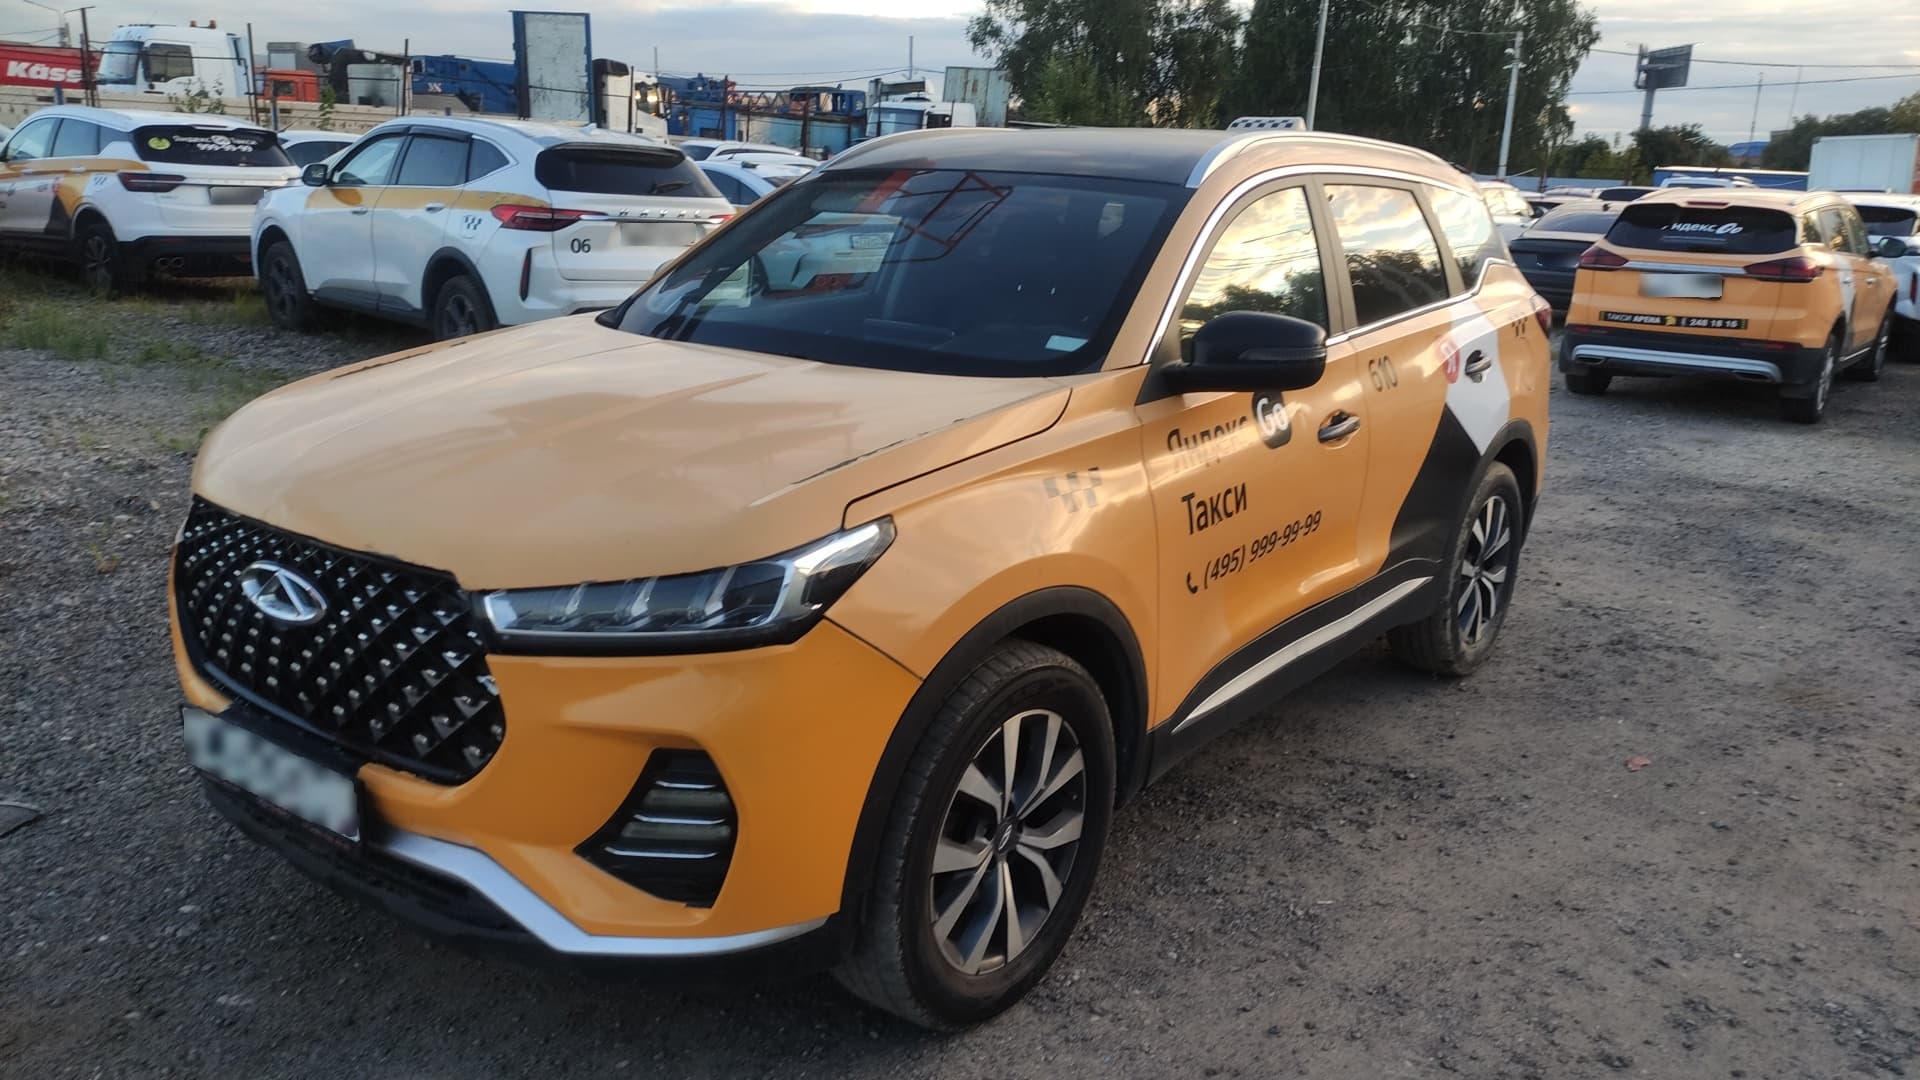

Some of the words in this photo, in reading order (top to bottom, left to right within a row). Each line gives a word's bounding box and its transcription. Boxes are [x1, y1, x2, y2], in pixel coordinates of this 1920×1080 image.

[6, 60, 97, 84] Käss
[570, 238, 592, 254] 06
[1367, 355, 1399, 393] 610
[1256, 397, 1289, 436] Go
[1181, 482, 1247, 536] Такси
[1203, 544, 1246, 590] (495)
[1249, 509, 1322, 563] 999-99-99
